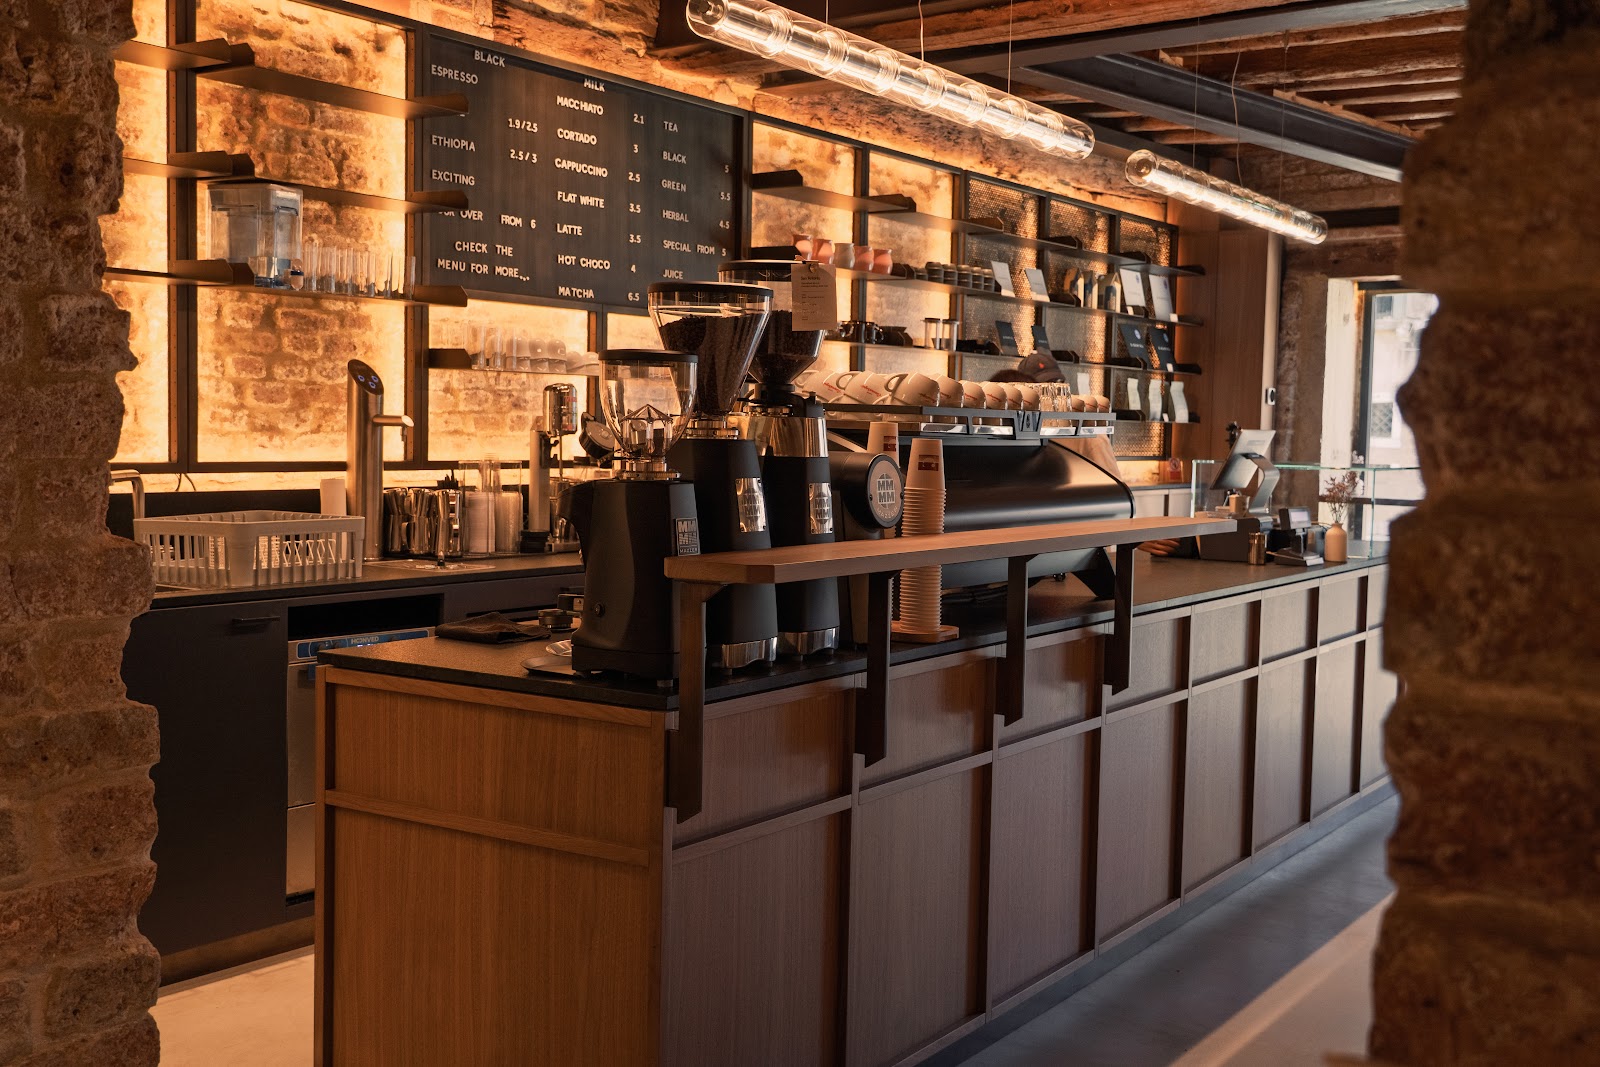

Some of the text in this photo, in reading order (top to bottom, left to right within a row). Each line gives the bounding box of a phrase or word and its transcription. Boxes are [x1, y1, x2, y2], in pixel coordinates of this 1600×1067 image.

[475, 50, 505, 67] BLACK
[432, 65, 478, 84] ESPRESSO
[584, 78, 606, 92] MILK
[557, 96, 645, 125] MACCHIATO 2.1
[663, 121, 679, 133] TEA
[432, 135, 475, 151] ETHIOPIA
[557, 128, 639, 154] CORTADO 3
[555, 158, 641, 183] CAPPUCCINO 2.5
[663, 151, 730, 174] BLACK 5
[431, 168, 475, 186] EXCITING
[662, 179, 731, 202] GREEN 5.5
[558, 191, 642, 214] FLAT WHITE 3.5
[461, 210, 483, 221] OVER
[501, 215, 522, 227] FROM
[530, 219, 537, 229] 6
[663, 210, 730, 230] HERBAL 4.5
[557, 223, 642, 244] LATTE 3.5
[456, 241, 513, 256] CHECK THE
[663, 240, 727, 257] SPECIAL FROM 5
[438, 259, 465, 271] MENU
[471, 263, 488, 274] FOR
[558, 255, 637, 274] HOT CHOCO 4
[663, 270, 683, 279] JUICE
[559, 286, 640, 302] MATCHA 6.5
